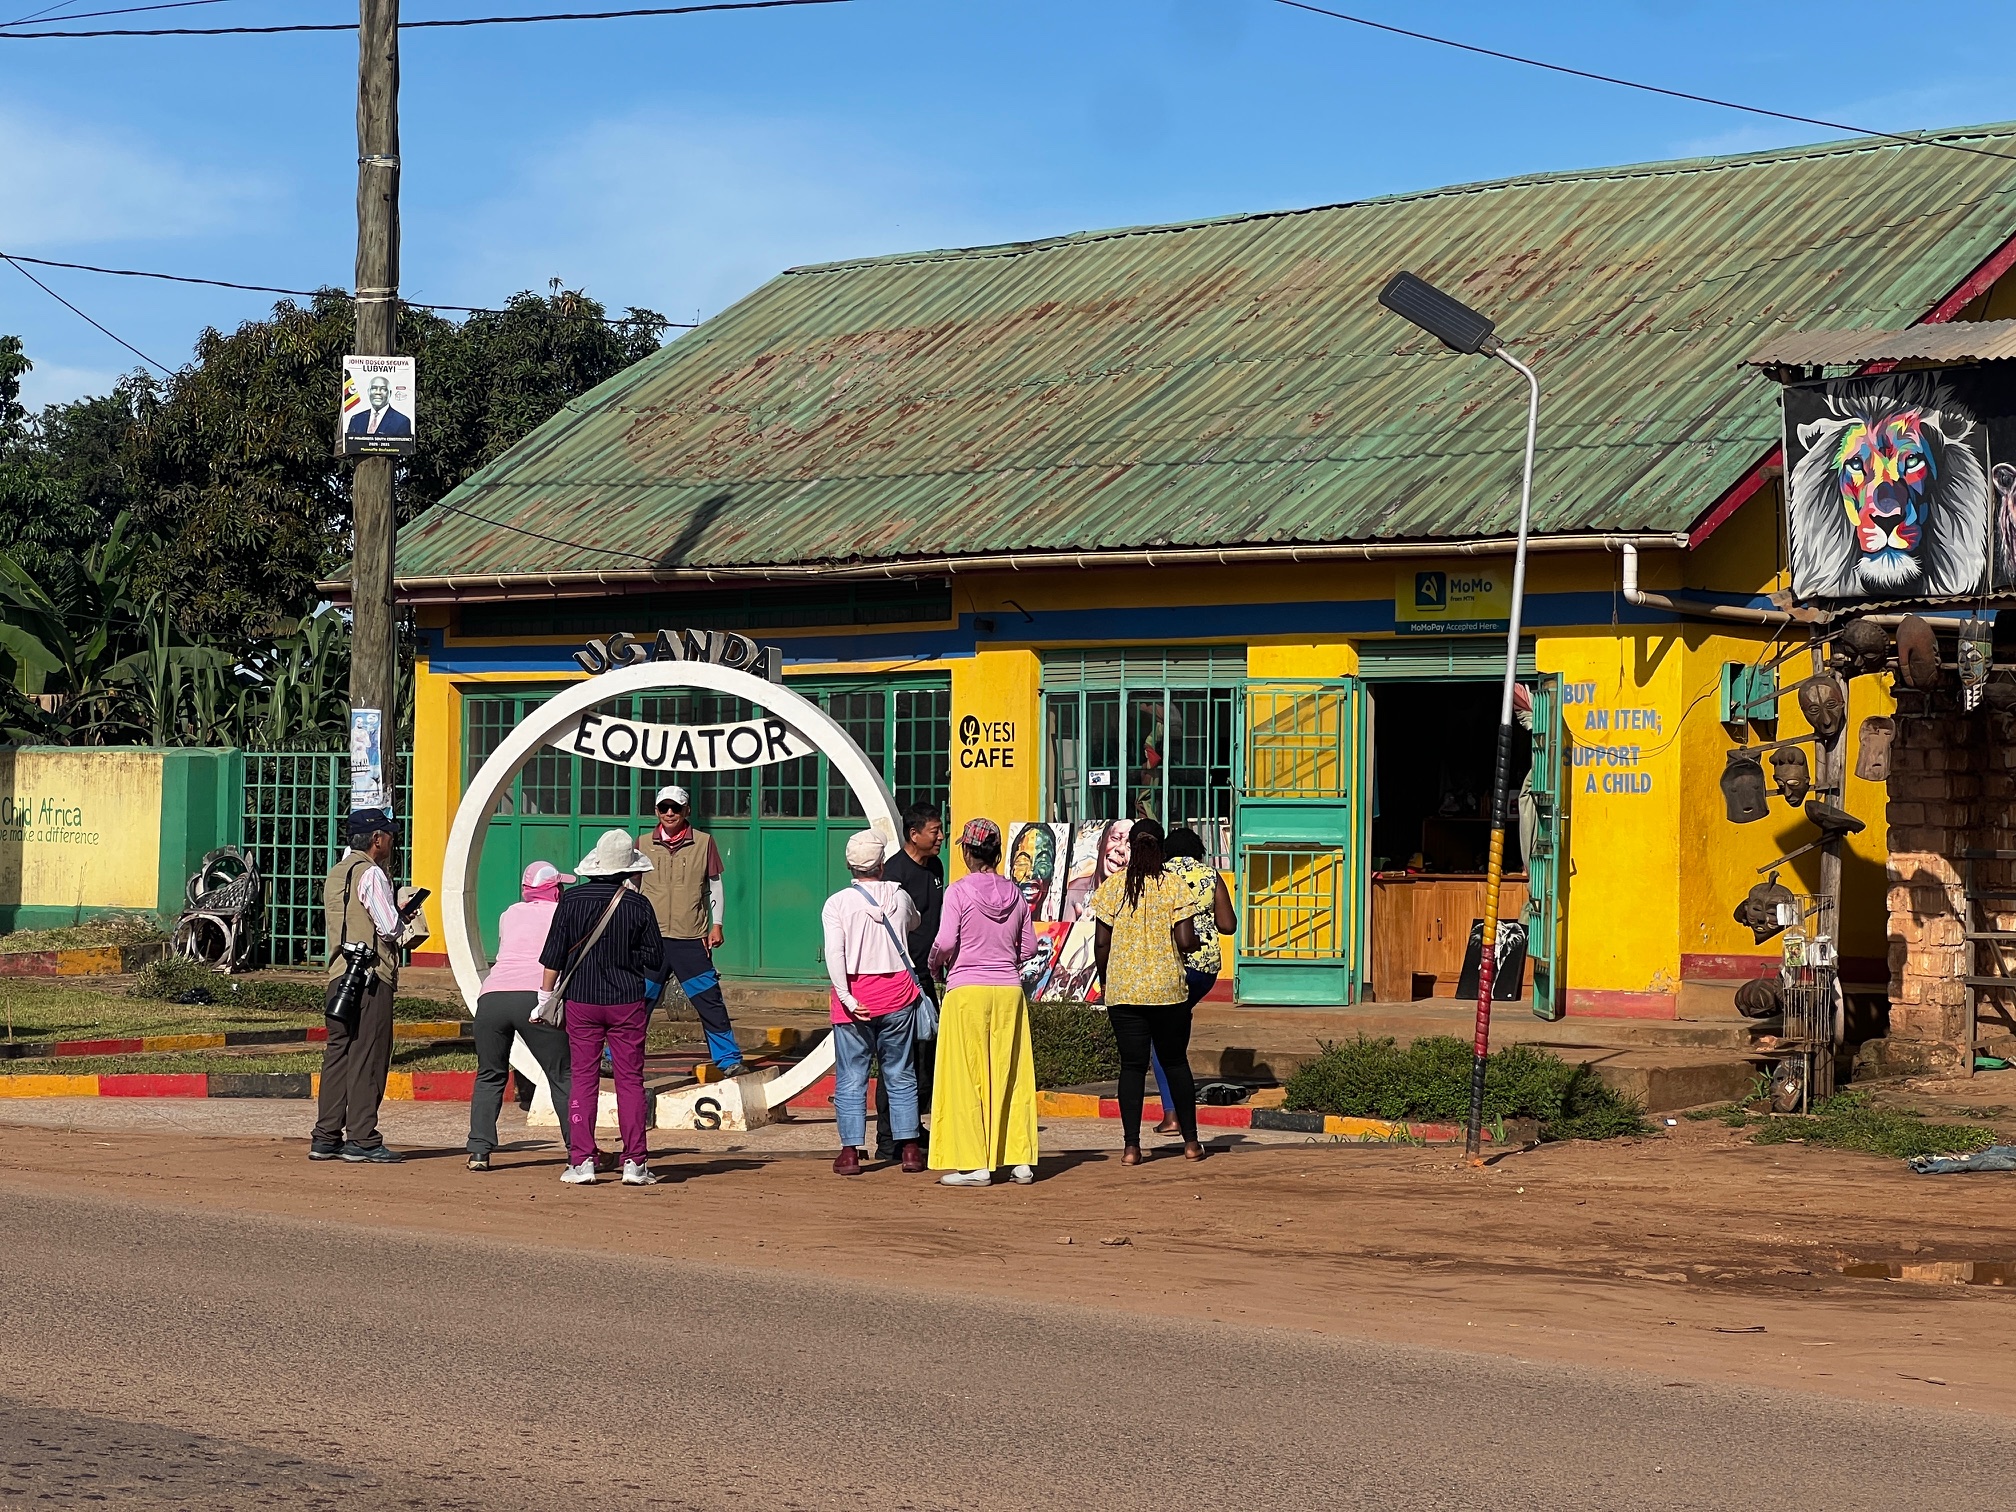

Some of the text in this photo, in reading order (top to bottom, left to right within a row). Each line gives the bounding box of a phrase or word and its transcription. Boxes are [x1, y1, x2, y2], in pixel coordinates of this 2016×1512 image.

[362, 365, 396, 373] LUBYAYI
[1450, 579, 1493, 593] MoMo
[1410, 623, 1445, 632] MoMoPay
[1446, 622, 1478, 632] Accepted
[572, 628, 782, 683] UGANDA
[1562, 683, 1597, 704] BUY
[982, 722, 1015, 742] YESI
[1585, 709, 1662, 736] AN ITEM;
[573, 714, 793, 769] EQUATOR
[960, 748, 1014, 768] CAFE
[1562, 746, 1641, 767] SUPPORT
[1585, 773, 1653, 793] A CHILD
[2, 796, 82, 827] Child Africa
[9, 826, 35, 842] make
[37, 830, 43, 842] a
[45, 826, 100, 845] difference
[693, 1096, 722, 1131] S
